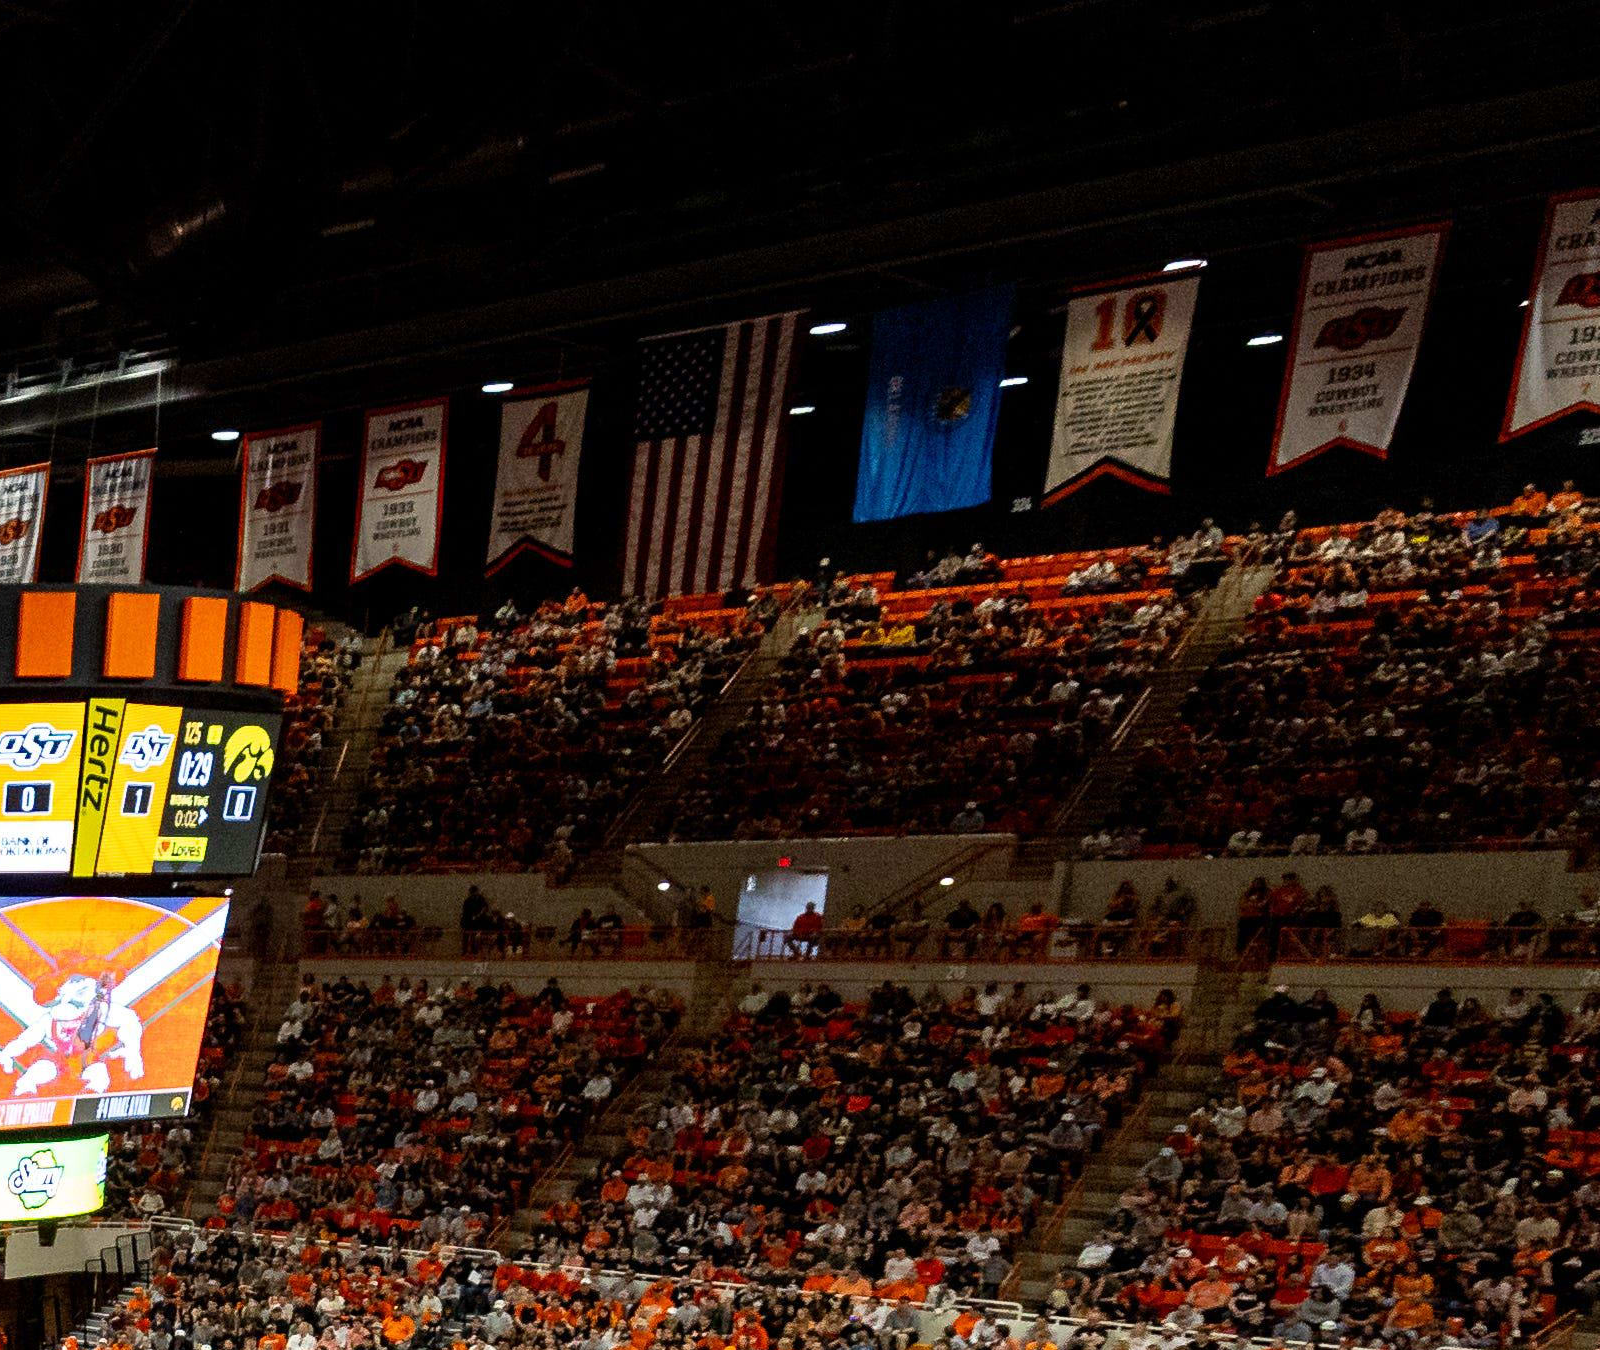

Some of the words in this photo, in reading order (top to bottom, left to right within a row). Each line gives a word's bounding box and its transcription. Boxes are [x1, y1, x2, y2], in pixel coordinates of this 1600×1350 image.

[1313, 266, 1426, 297] CHAMPIONS
[1327, 362, 1377, 385] 1934
[1316, 384, 1378, 403] COWBOY
[184, 721, 203, 746] 125
[82, 705, 118, 812] Hertz
[118, 724, 176, 772] OSU
[177, 751, 213, 786] 0:29
[21, 786, 35, 812] 0
[174, 810, 199, 828] 0:02
[7, 1153, 65, 1201] Starry
